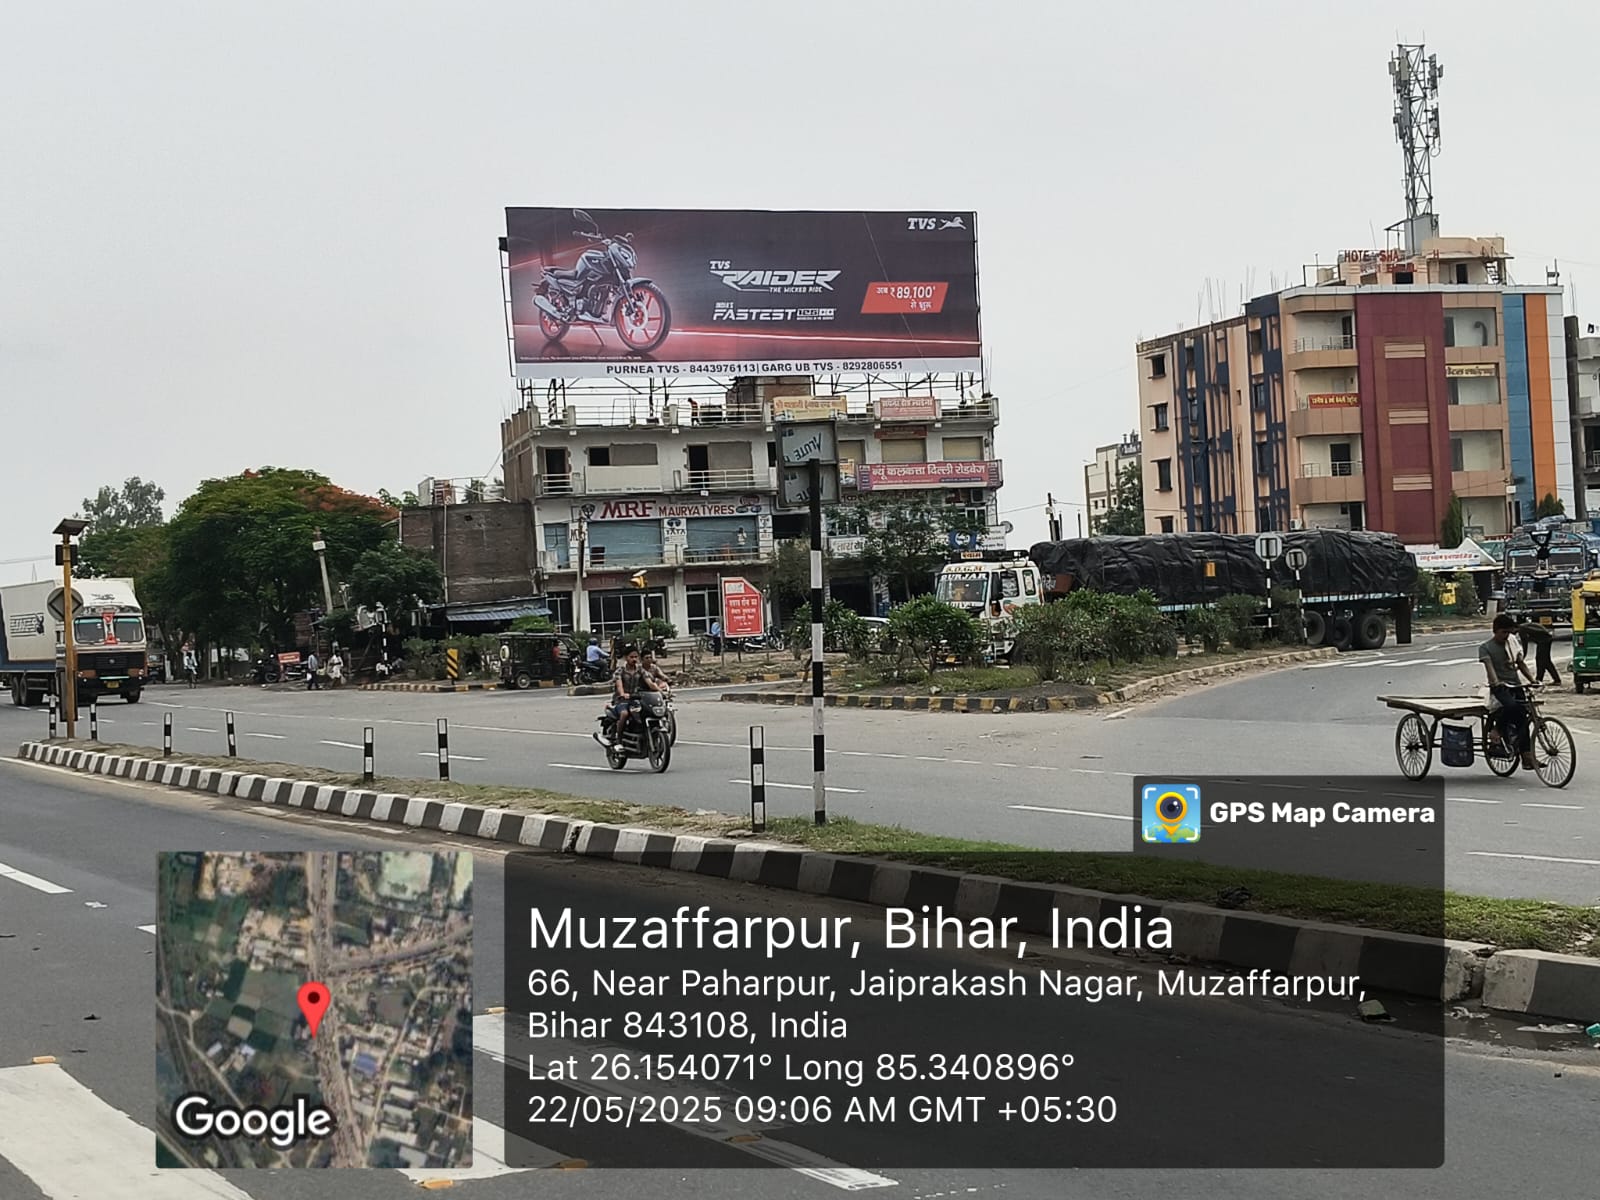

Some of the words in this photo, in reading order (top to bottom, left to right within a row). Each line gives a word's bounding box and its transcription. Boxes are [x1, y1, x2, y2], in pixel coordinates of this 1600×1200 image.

[907, 217, 937, 230] TVS
[709, 260, 731, 270] TVS
[709, 270, 842, 291] RAIDER
[712, 308, 797, 321] FASTEST
[606, 365, 655, 374] PURNEA
[656, 364, 680, 374] TVS
[795, 362, 811, 372] UB
[813, 361, 834, 371] TVS
[842, 360, 903, 371] 8292806551
[871, 466, 888, 481] न्यू
[887, 465, 926, 477] कलकत्ता
[927, 463, 954, 476] दिल्ली
[599, 500, 657, 519] MRF
[658, 505, 699, 517] MAURYA
[700, 503, 736, 516] TYRES
